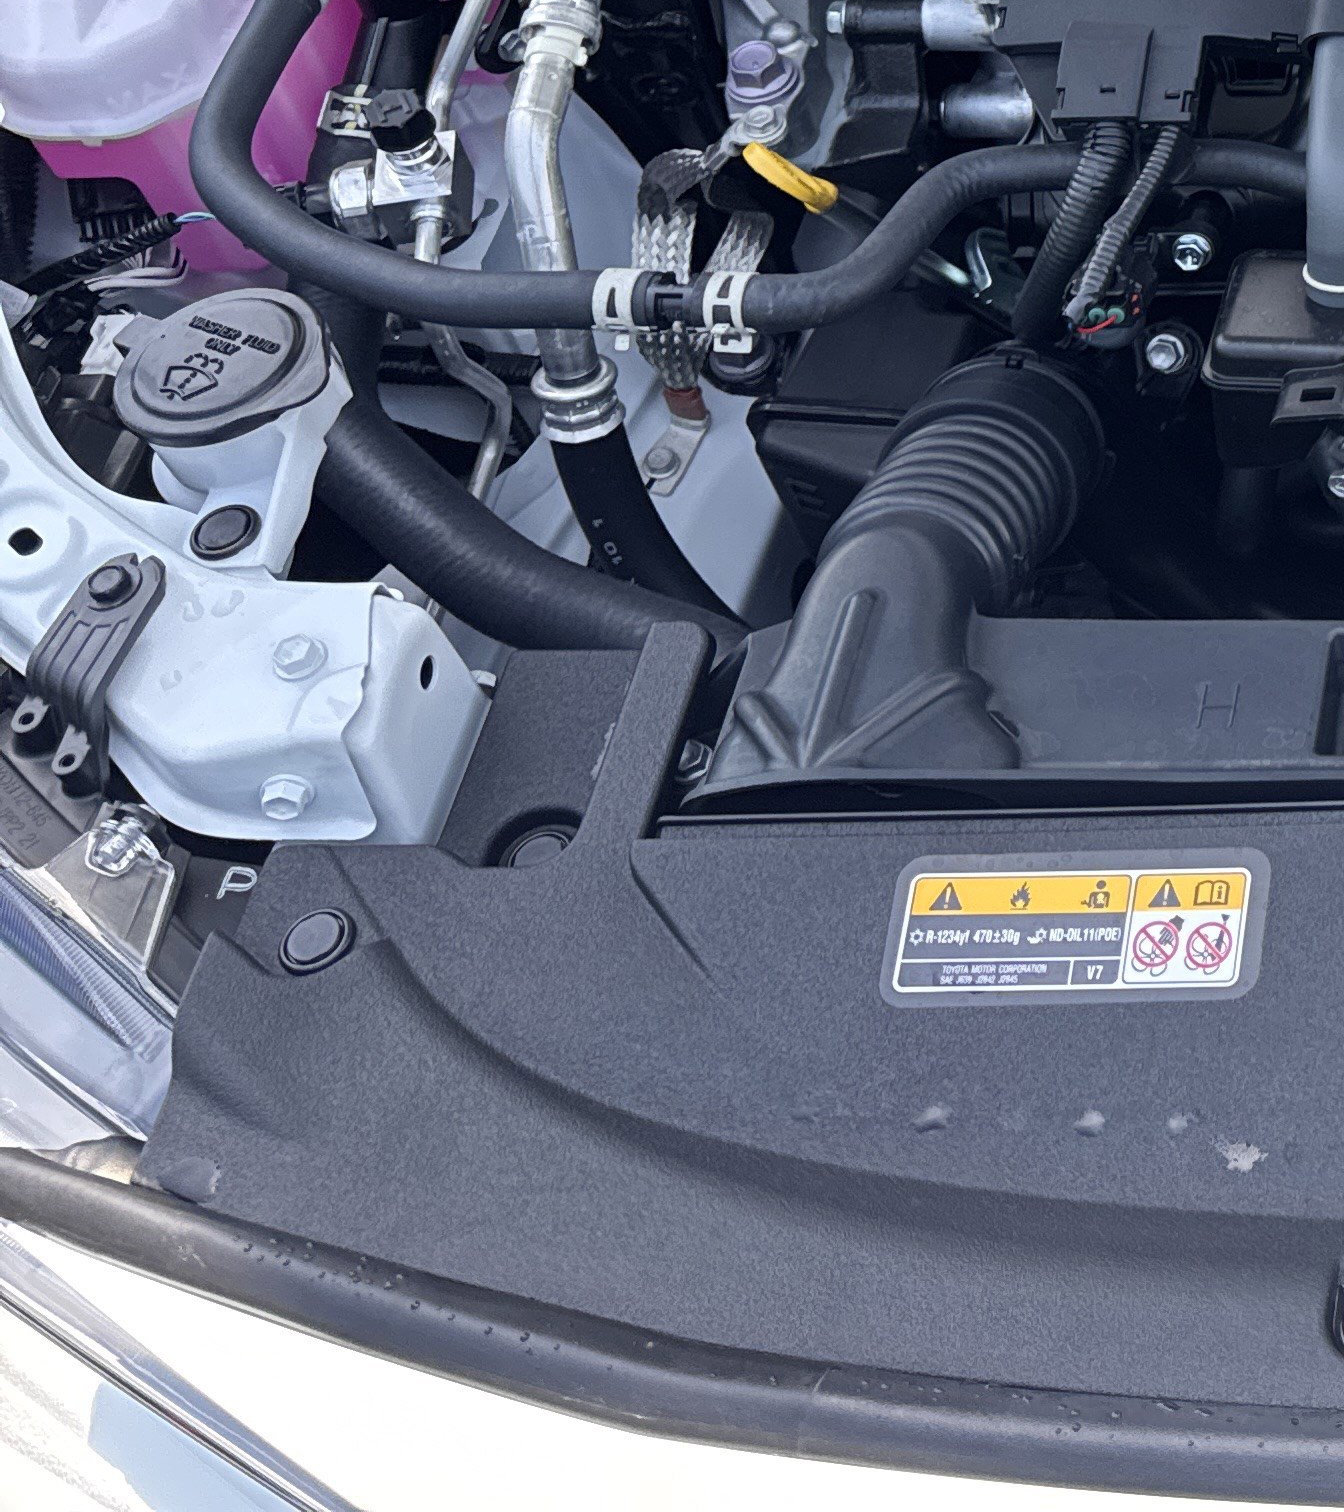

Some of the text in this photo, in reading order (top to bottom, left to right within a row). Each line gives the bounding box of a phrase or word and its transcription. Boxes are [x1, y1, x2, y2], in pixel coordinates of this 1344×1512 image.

[205, 337, 241, 356] ONLY
[1196, 682, 1241, 729] H
[216, 866, 257, 899] P
[973, 929, 1021, 945] 470±30g
[1049, 927, 1121, 943] ND-OIL11(POE)
[942, 963, 1104, 981] TOYOTA MOTOR CORPORATION V7
